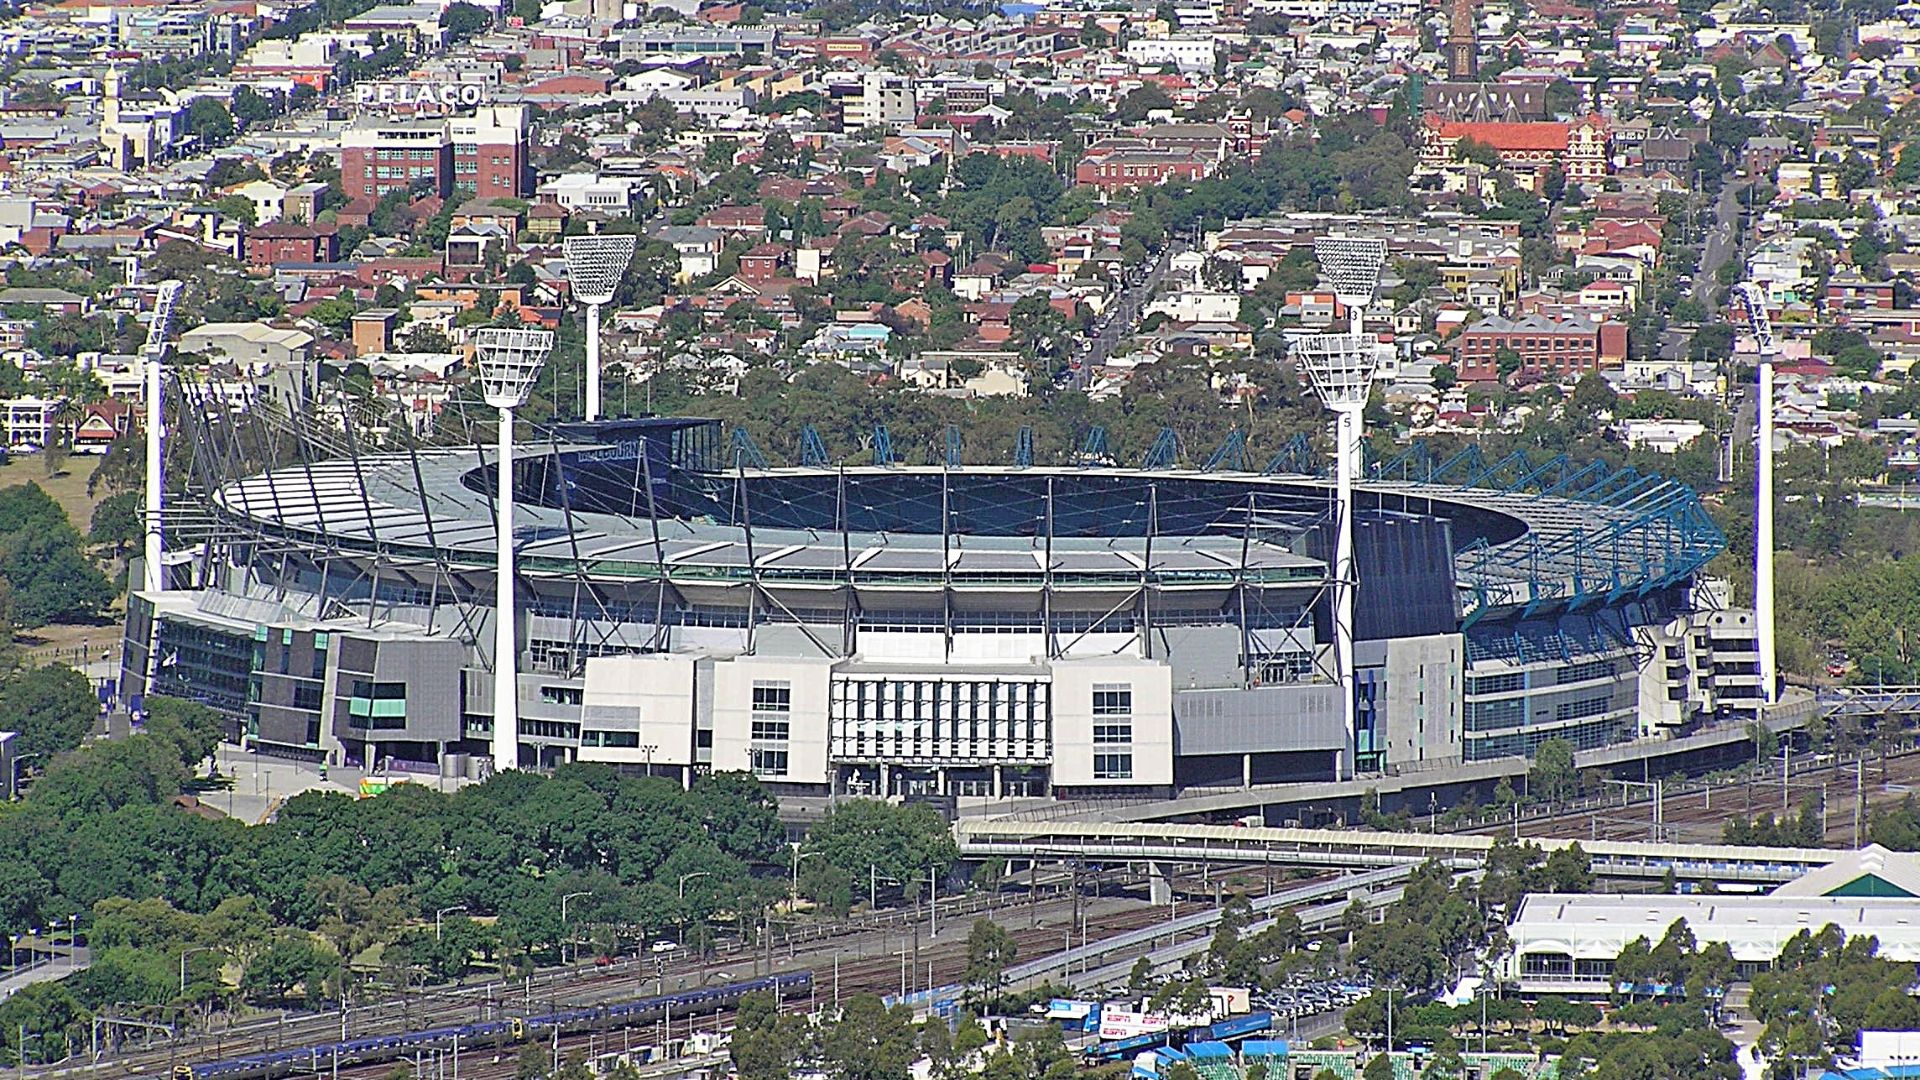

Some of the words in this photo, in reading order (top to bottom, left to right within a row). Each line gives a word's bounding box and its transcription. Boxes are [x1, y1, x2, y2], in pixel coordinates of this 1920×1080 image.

[357, 84, 481, 105] PELACO
[1351, 310, 1358, 320] 3
[1344, 417, 1351, 427] 5
